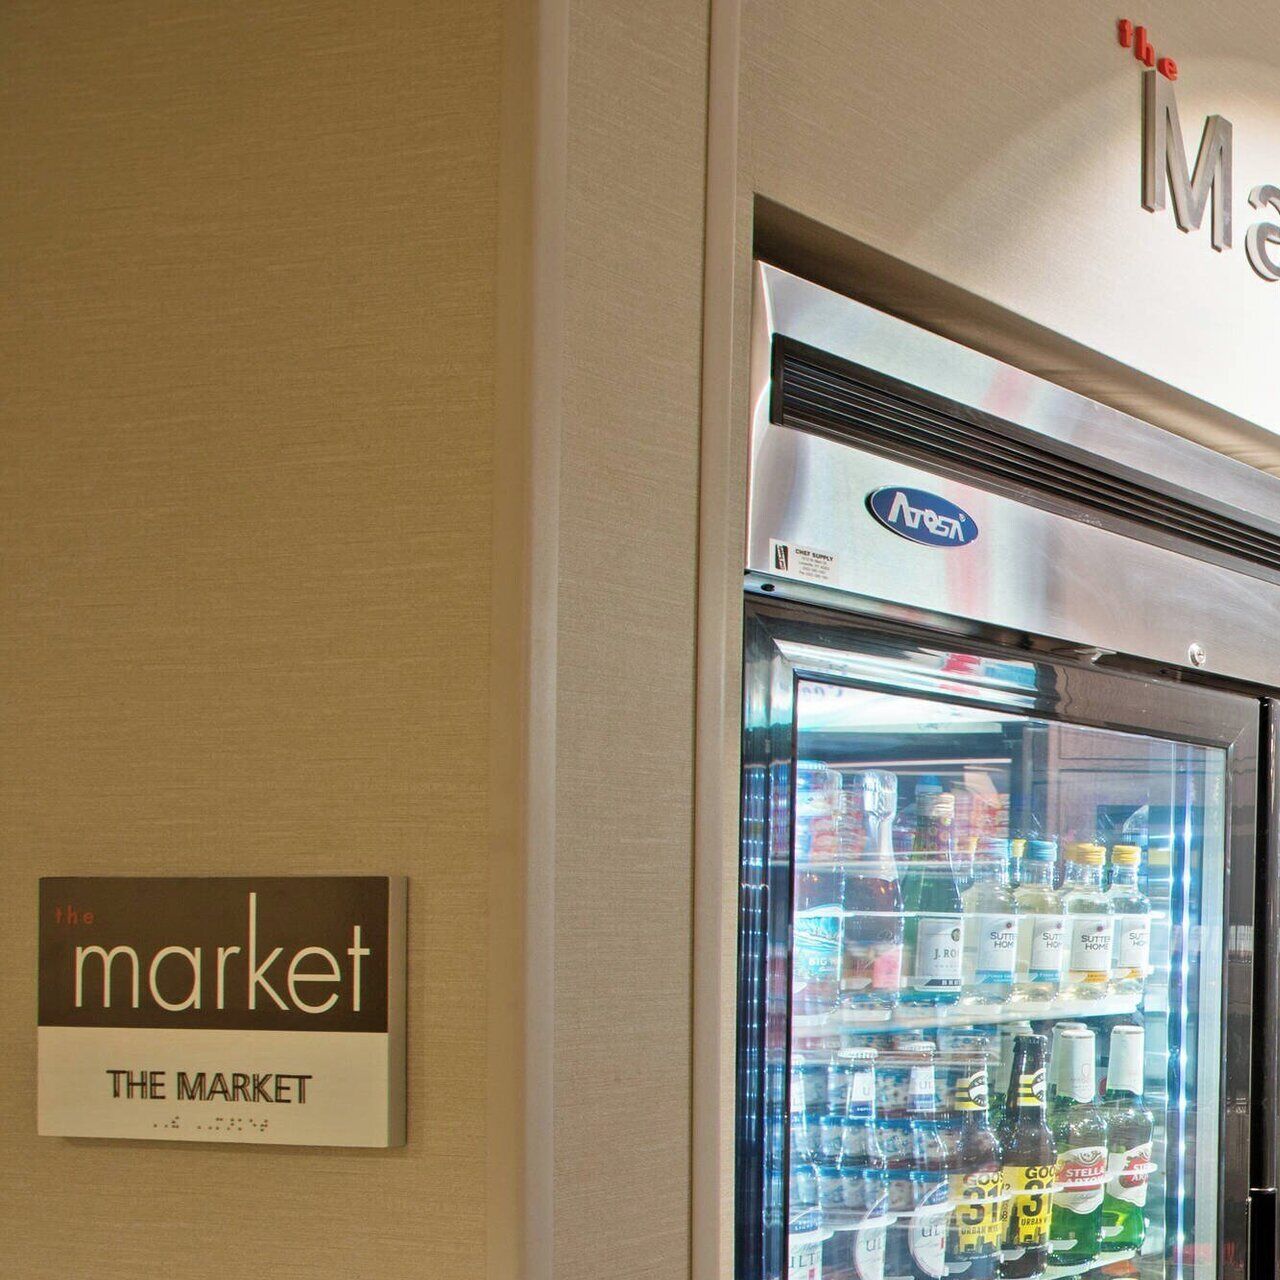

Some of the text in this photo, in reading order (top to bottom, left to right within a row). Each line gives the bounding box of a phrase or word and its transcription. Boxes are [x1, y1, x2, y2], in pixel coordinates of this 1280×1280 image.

[1115, 18, 1178, 81] the
[55, 905, 94, 925] the
[75, 892, 370, 1014] market
[1081, 935, 1111, 943] SUTTE
[106, 1070, 313, 1105] THE MARKET
